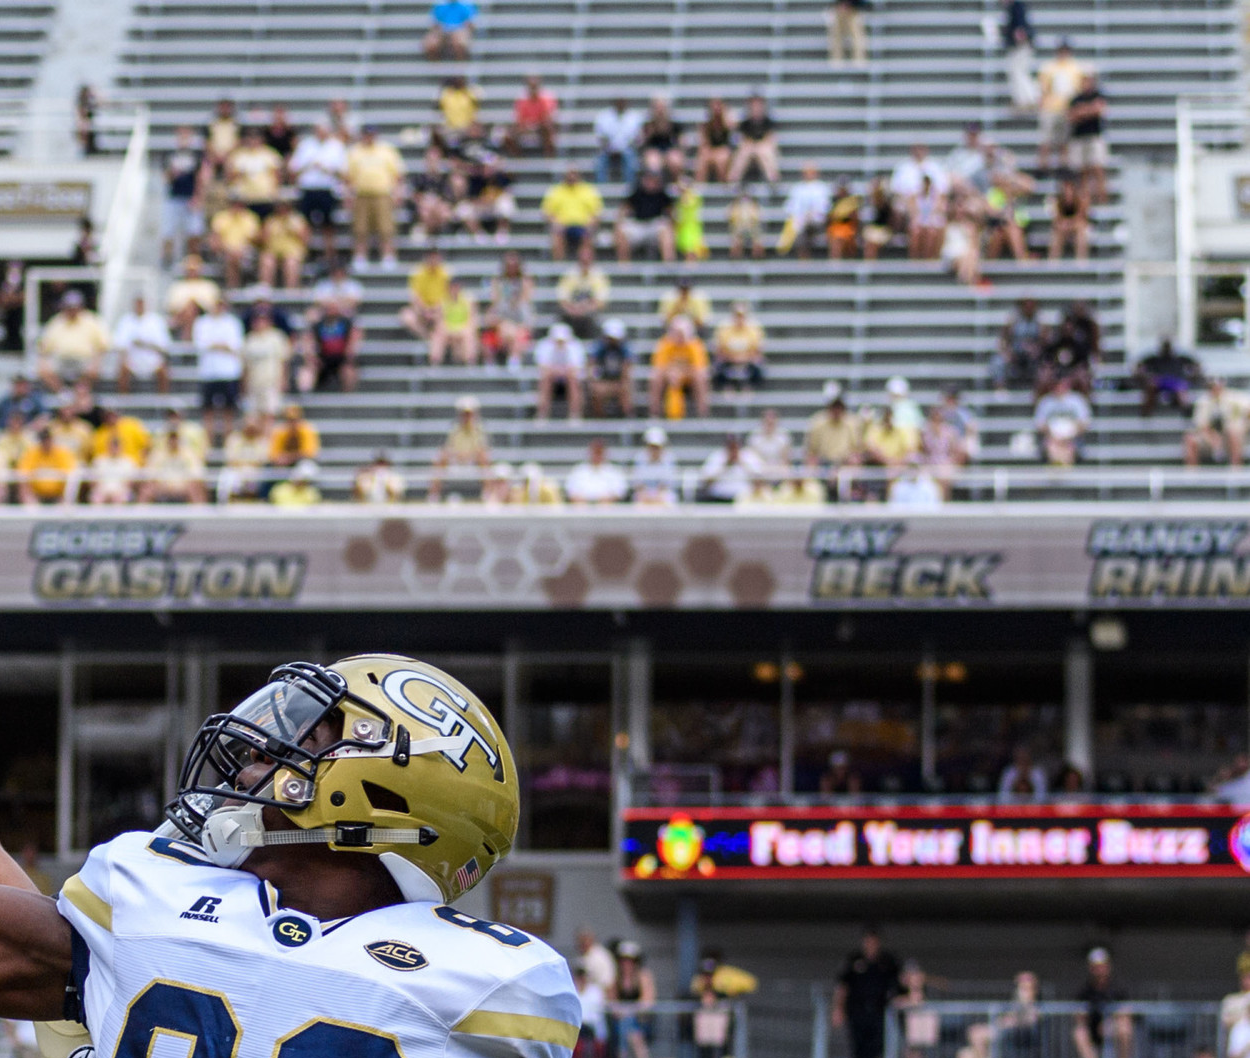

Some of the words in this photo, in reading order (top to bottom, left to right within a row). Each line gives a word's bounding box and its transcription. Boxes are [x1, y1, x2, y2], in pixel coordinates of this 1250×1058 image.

[31, 525, 183, 557] BOBBY
[809, 523, 905, 557] RAY
[1087, 523, 1249, 556] RANDY
[35, 555, 306, 599] GASTON
[812, 555, 1002, 599] BECK
[750, 821, 856, 866] Feed
[863, 820, 963, 865] Your
[970, 820, 1091, 865] Inner
[1098, 819, 1209, 865] Buzz
[179, 911, 220, 924] RUSSELL
[374, 942, 421, 965] ACC
